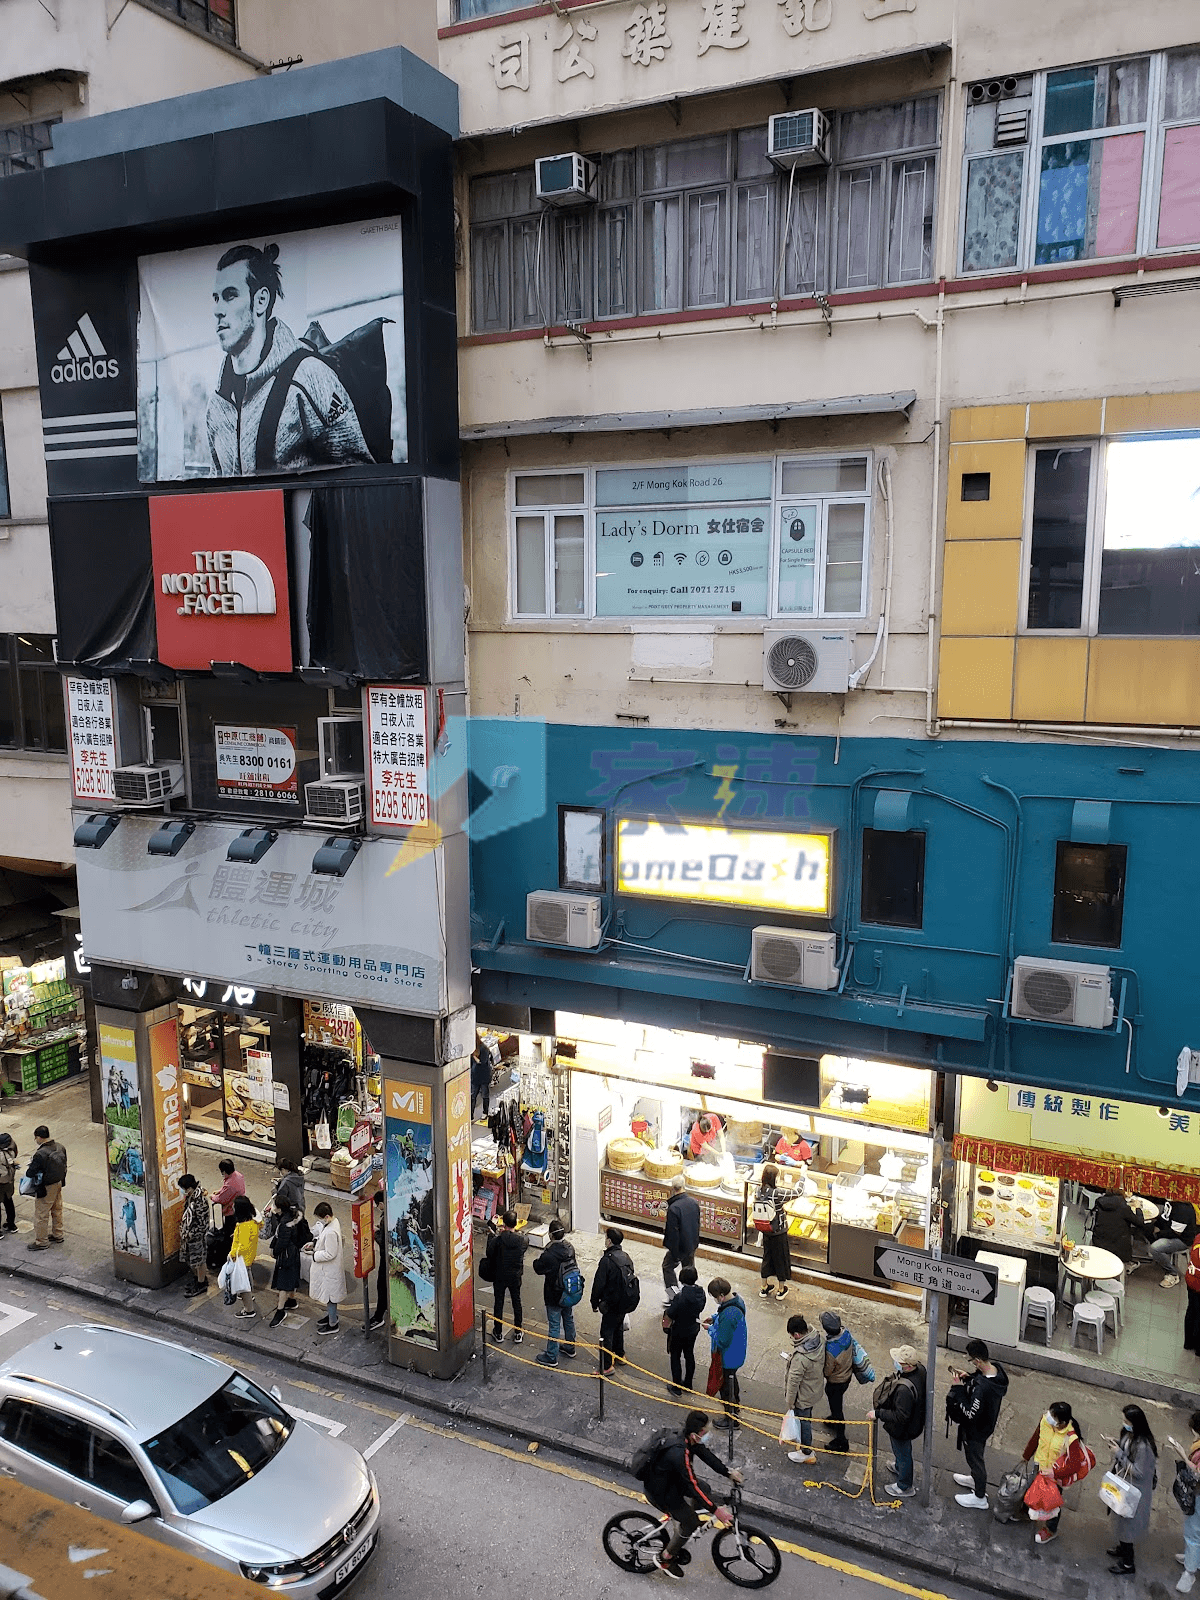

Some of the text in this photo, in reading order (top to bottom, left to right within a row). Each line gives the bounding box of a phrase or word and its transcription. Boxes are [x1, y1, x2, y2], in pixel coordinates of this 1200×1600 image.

[384, 222, 399, 232] BALE
[50, 356, 120, 384] adidas
[632, 477, 723, 492] 2/F Mong Kok Road 26
[601, 517, 765, 543] Lady's Dorm 女仕宿舍
[192, 550, 233, 572] THE
[161, 572, 234, 595] NORTH
[639, 588, 669, 596] enquiry:
[670, 586, 689, 594] Call
[690, 586, 711, 594] 7071
[713, 585, 736, 594] 2715
[77, 699, 105, 713] 日夜人流
[71, 715, 112, 730] 適合各行各業
[380, 712, 415, 728] 日夜人流
[372, 731, 424, 748] 適合各行各業
[80, 749, 108, 767] 李先生
[239, 755, 264, 767] 8300
[267, 757, 292, 769] 0161
[373, 750, 425, 767] 特大廣告招牌
[76, 767, 95, 793] 5295
[381, 769, 418, 790] 李先生
[254, 789, 275, 797] 2810
[276, 790, 298, 799] 6066
[375, 789, 426, 821] 5295 8078
[207, 864, 345, 915] 體運城
[290, 915, 339, 948] city
[244, 942, 426, 980] 一幢三層式運動用品專門店
[266, 956, 299, 970] Storey
[303, 961, 349, 978] Sporting
[354, 970, 389, 983] Goods
[394, 975, 424, 989] Store
[1016, 1089, 1120, 1121] 傳統製作
[897, 1255, 972, 1281] Mong Kok Road
[888, 1267, 980, 1296] 18-28 旺角道 30-44
